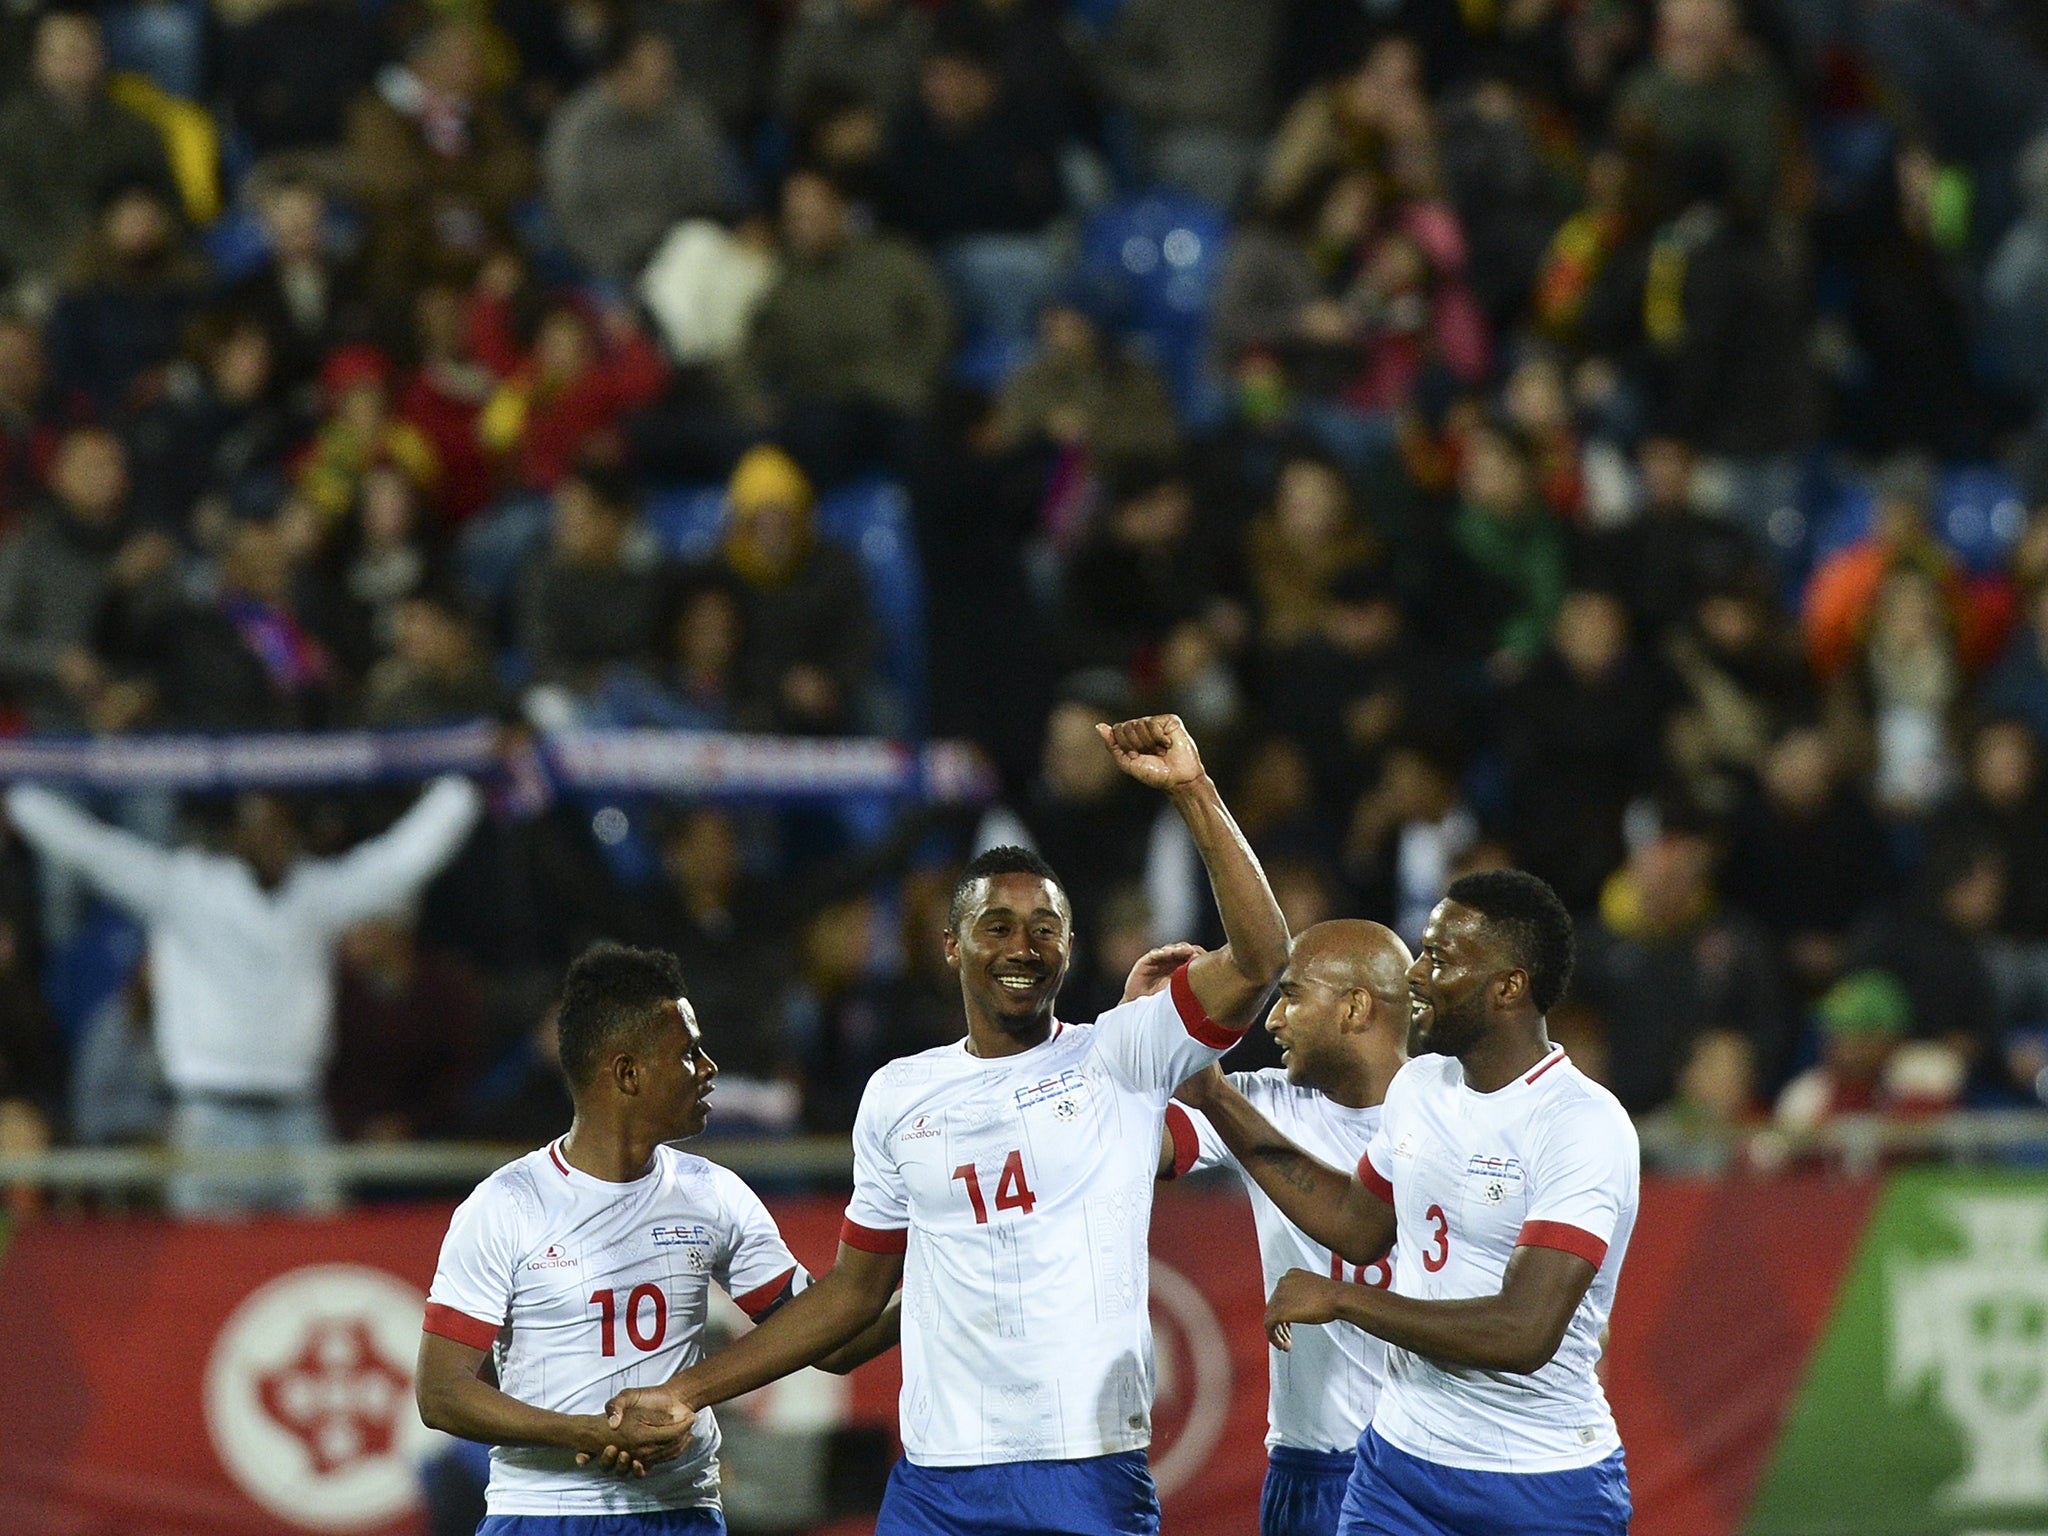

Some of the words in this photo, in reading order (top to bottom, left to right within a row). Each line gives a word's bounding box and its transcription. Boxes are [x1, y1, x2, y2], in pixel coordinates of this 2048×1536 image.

[951, 1149, 1037, 1225] 14
[526, 1258, 579, 1271] Lacatoni
[1422, 1204, 1449, 1273] 3
[588, 1282, 668, 1358] 10
